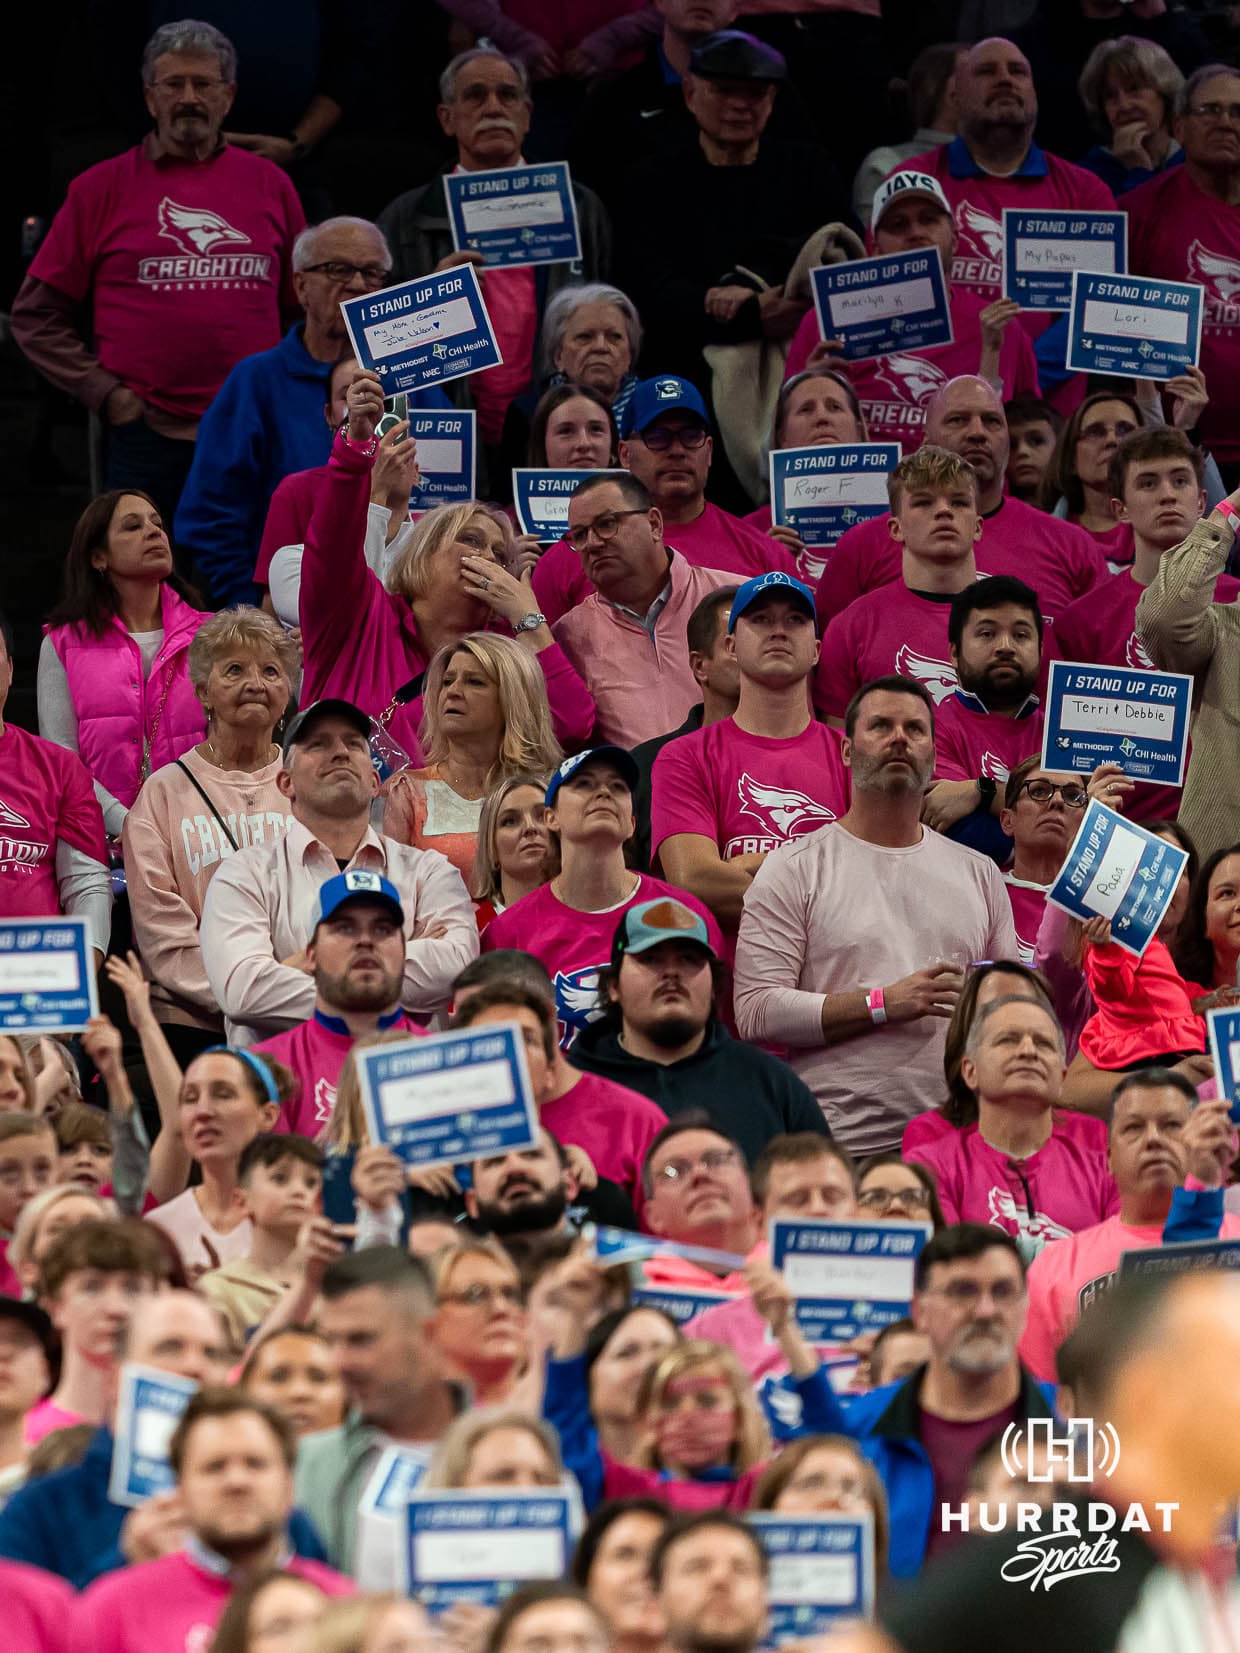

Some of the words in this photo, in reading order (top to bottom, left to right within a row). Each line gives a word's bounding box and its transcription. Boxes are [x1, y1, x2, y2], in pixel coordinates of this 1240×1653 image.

[461, 185, 464, 196] I
[469, 180, 509, 195] STAND
[512, 177, 529, 190] UP
[533, 174, 557, 186] FOR
[882, 174, 934, 202] JAYS
[1017, 220, 1022, 232] I
[1026, 221, 1066, 232] STAND
[1070, 222, 1087, 233] UP
[1090, 223, 1115, 234] FOR
[141, 257, 271, 280] CREIGHTON
[828, 276, 832, 288] I
[837, 269, 878, 287] STAND
[882, 264, 899, 278] UP
[904, 259, 928, 274] FOR
[361, 308, 365, 320] I
[369, 294, 412, 318] STAND
[416, 288, 433, 303] UP
[437, 279, 463, 296] FOR
[1088, 282, 1094, 293] I
[1097, 284, 1139, 299] STAND
[1144, 289, 1160, 300] UP
[1164, 293, 1190, 305] FOR
[1115, 310, 1146, 323] Lori
[390, 356, 429, 371] METHODIST
[449, 347, 461, 356] CHI
[464, 339, 489, 353] Health
[422, 368, 441, 378] NABC
[416, 421, 432, 432] UP
[437, 421, 462, 432] FOR
[786, 460, 789, 471] I
[794, 457, 836, 470] STAND
[840, 455, 858, 466] UP
[862, 454, 888, 465] FOR
[443, 484, 467, 492] Health
[529, 480, 533, 491] I
[794, 479, 830, 499] Roger
[1066, 675, 1072, 688] I
[1075, 676, 1122, 692] STAND
[1127, 681, 1145, 694] UP
[1149, 684, 1176, 698] FOR
[1072, 701, 1109, 715] Terri
[1126, 704, 1166, 722] Debbie
[1073, 743, 1114, 751] METHODIST
[1135, 750, 1149, 758] CHI
[1150, 752, 1176, 762] Health
[1070, 848, 1096, 888] STAND
[1089, 830, 1101, 850] UP
[1095, 813, 1110, 835] FOR
